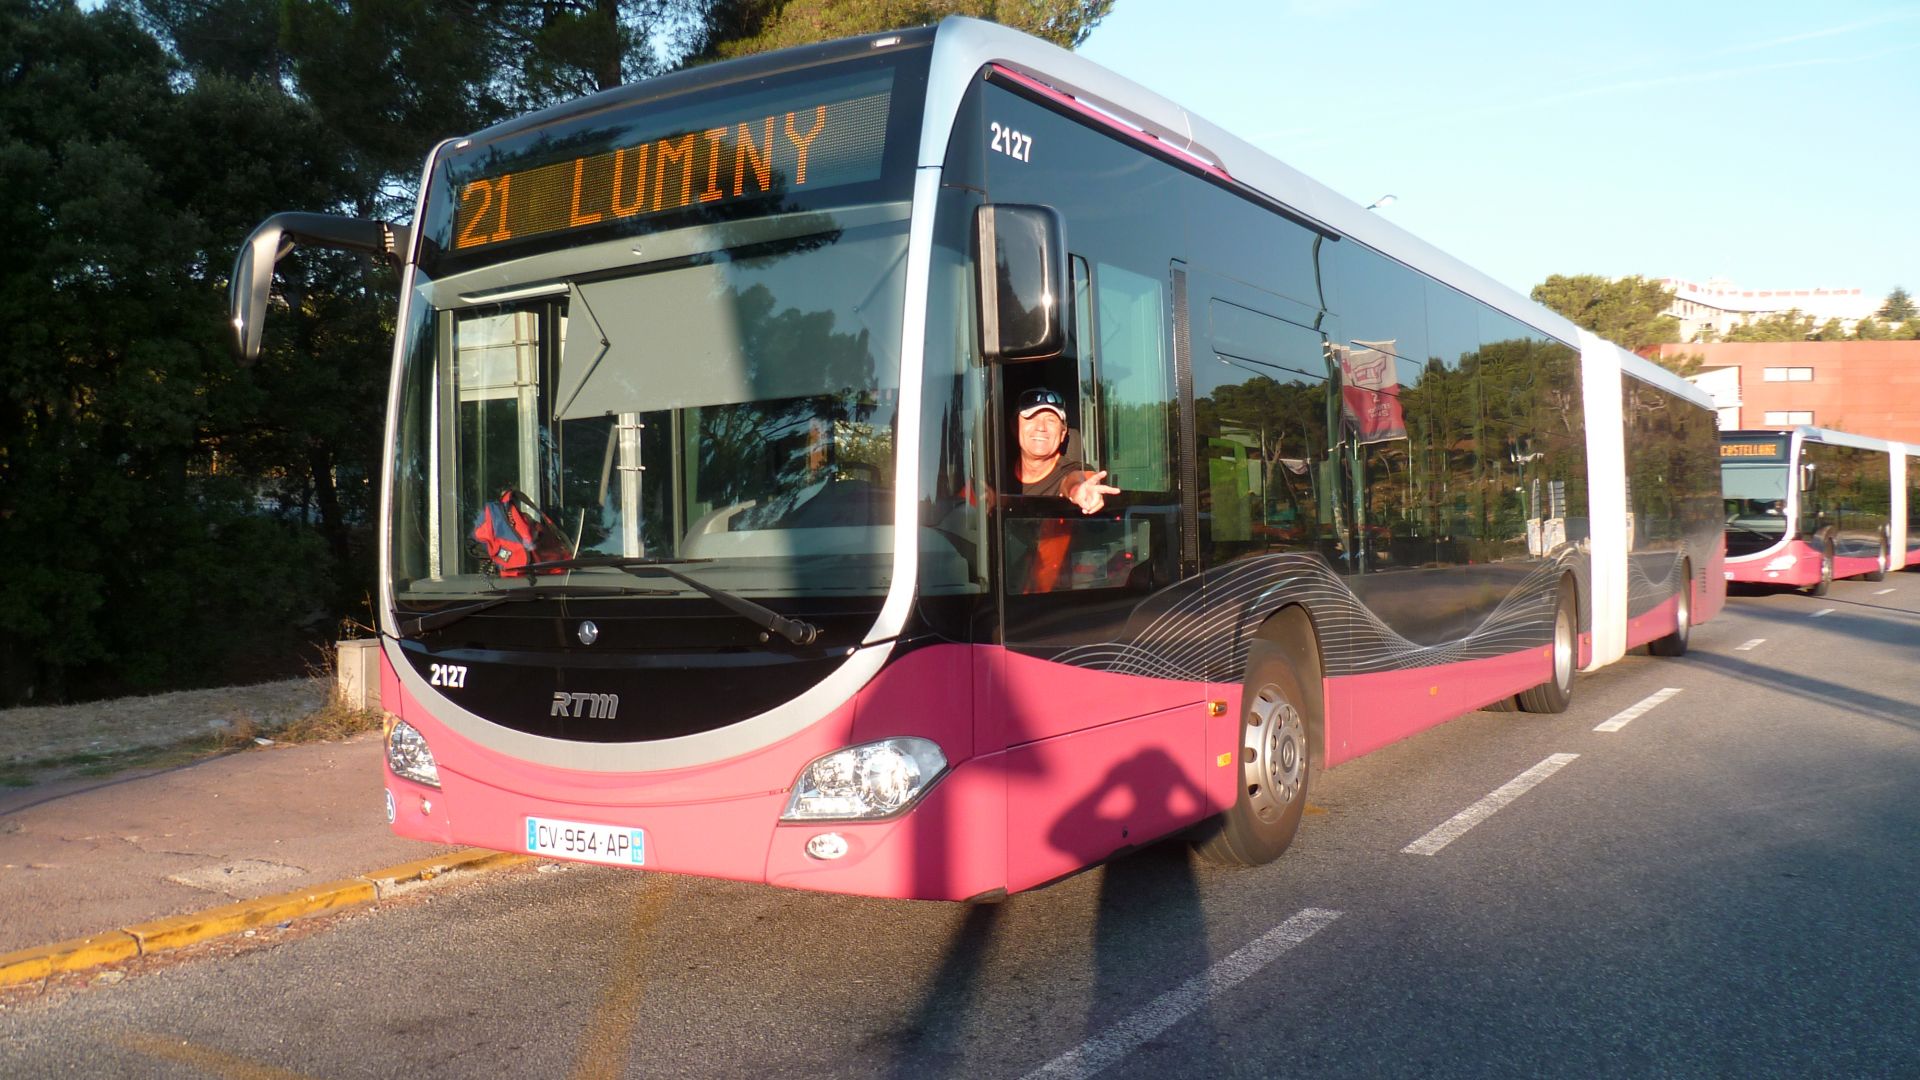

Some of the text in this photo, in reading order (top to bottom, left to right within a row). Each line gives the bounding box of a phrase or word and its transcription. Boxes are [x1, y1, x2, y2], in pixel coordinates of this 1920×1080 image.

[990, 121, 1032, 163] 2127
[455, 104, 827, 250] 21 LUMINY
[430, 663, 468, 689] 2127
[550, 691, 620, 720] RTM
